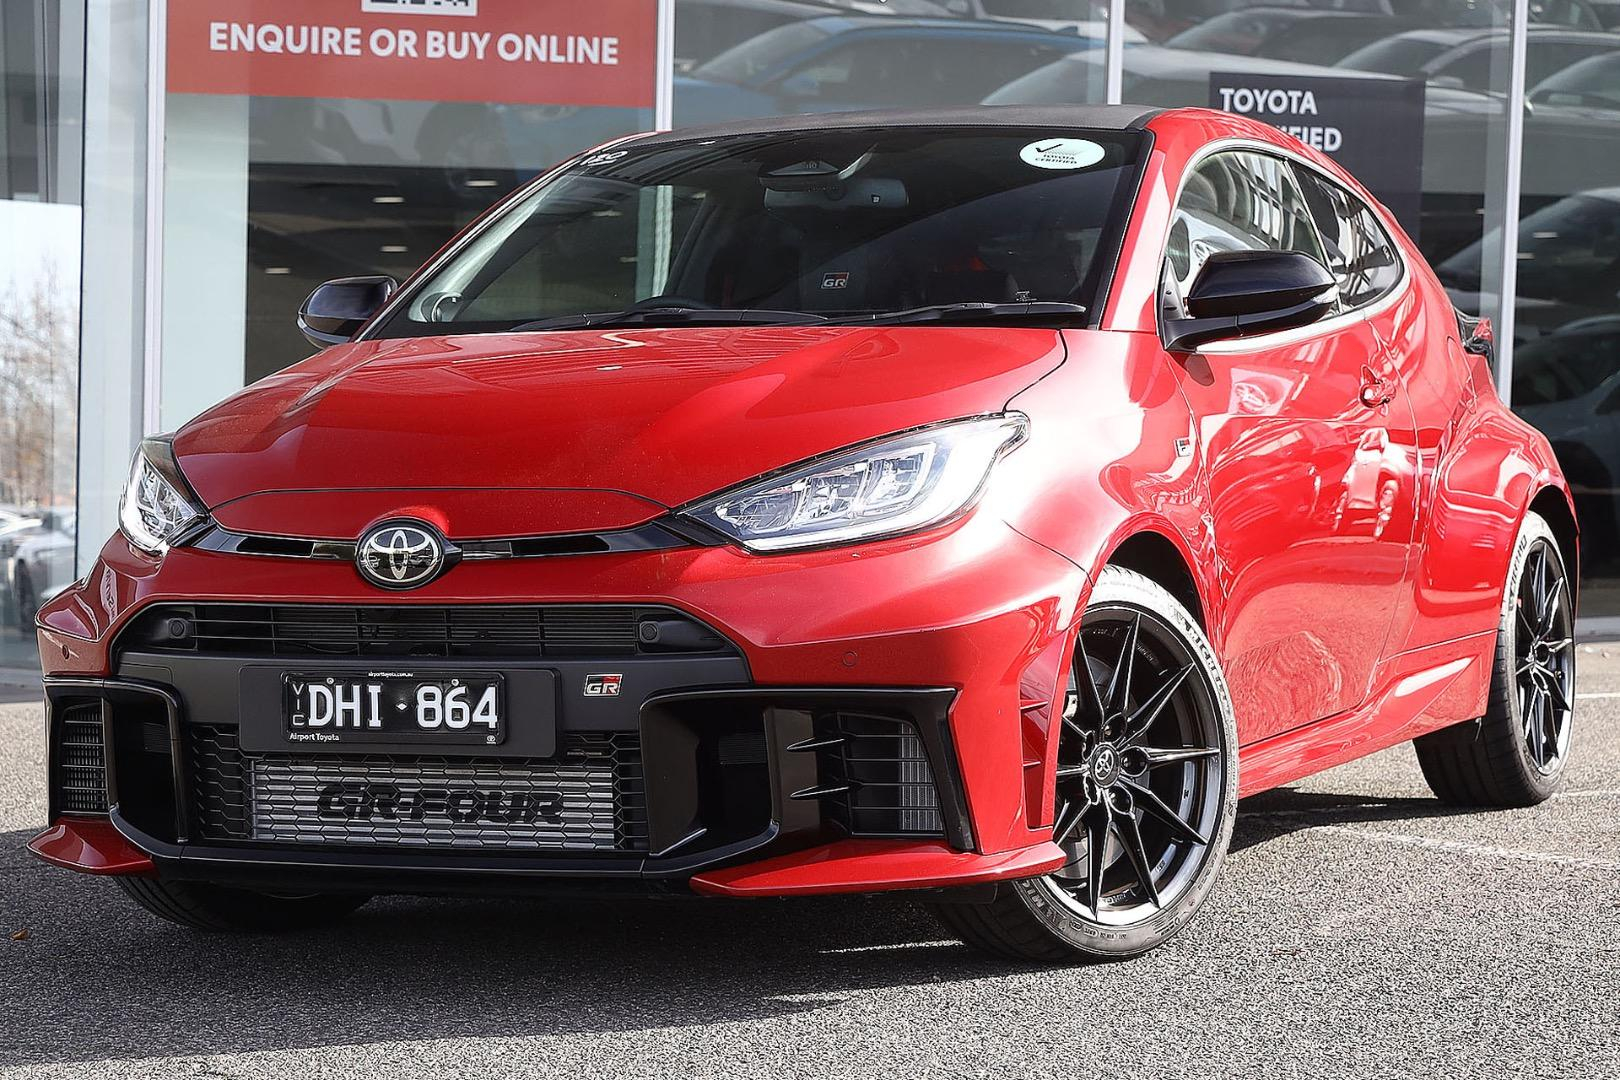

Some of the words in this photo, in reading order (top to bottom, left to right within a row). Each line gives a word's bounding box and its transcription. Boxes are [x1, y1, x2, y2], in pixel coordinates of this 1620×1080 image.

[210, 22, 361, 55] ENQUIRE
[369, 28, 418, 57] OR
[426, 31, 490, 59] BUY
[497, 34, 618, 65] ONLINE
[1219, 88, 1317, 115] TOYOTA
[823, 278, 846, 287] GR
[586, 682, 618, 694] GR
[308, 684, 382, 727] DHI
[416, 685, 498, 729] 864
[289, 732, 315, 742] Airport
[315, 732, 340, 742] Toyota
